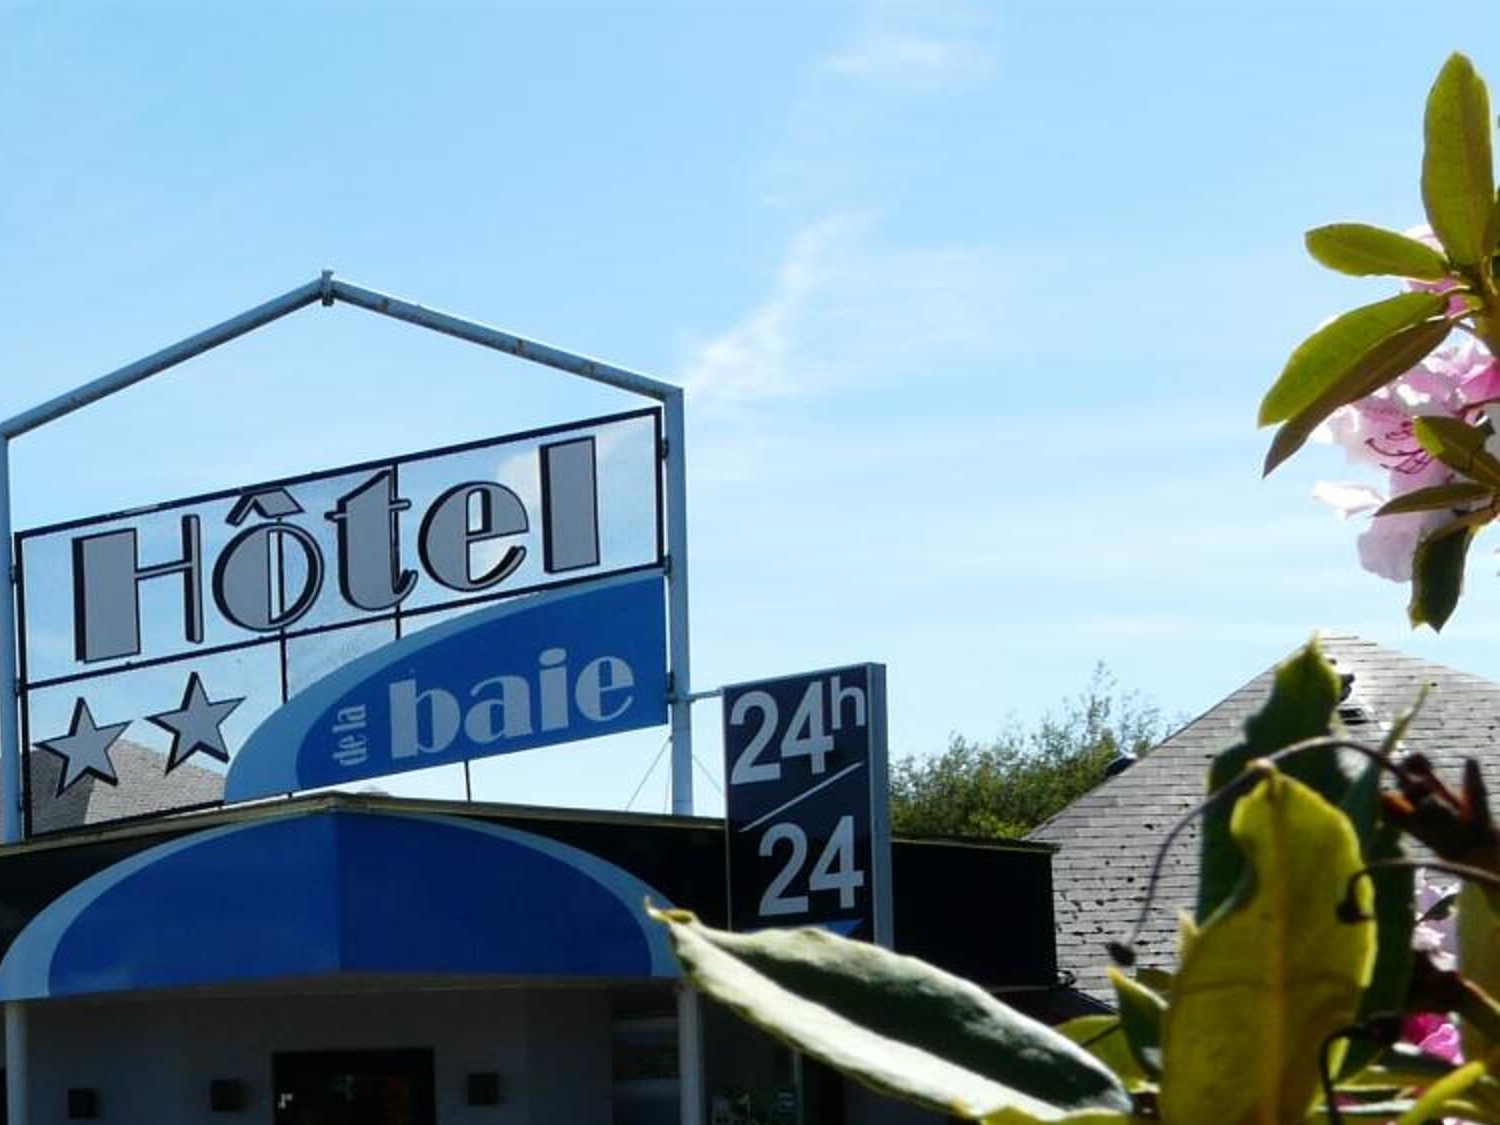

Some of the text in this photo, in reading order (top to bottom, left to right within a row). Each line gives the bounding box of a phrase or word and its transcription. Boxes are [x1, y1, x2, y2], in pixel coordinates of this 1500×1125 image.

[72, 435, 601, 664] Hôtel
[331, 704, 368, 766] de la
[389, 648, 635, 759] baie
[730, 676, 867, 784] 24h
[758, 815, 864, 917] 24
